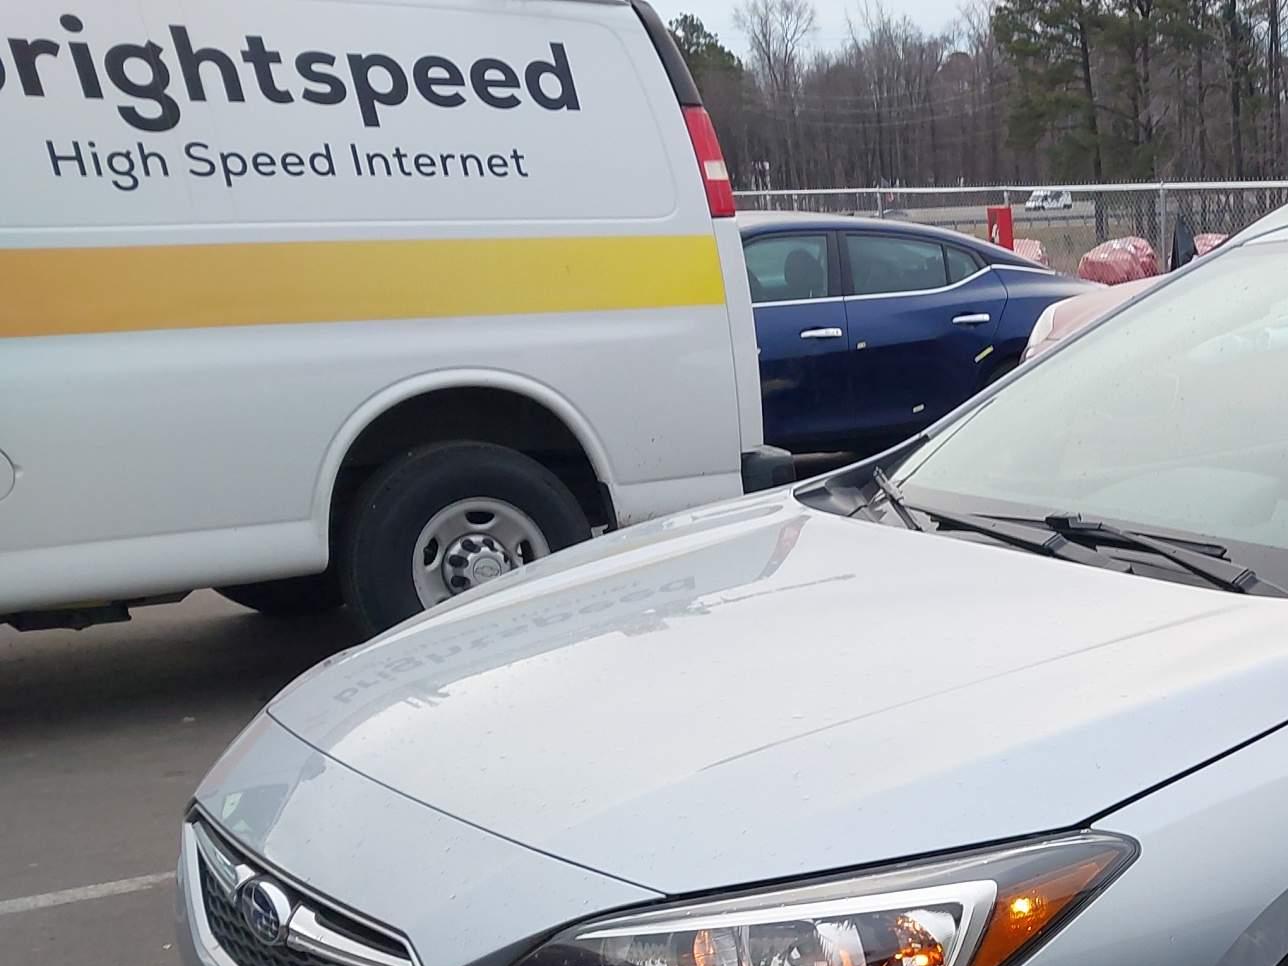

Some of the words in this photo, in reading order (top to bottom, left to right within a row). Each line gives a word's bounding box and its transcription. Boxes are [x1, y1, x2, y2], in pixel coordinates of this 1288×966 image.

[0, 14, 581, 132] rightspeed
[46, 140, 170, 192] High
[184, 141, 337, 188] Speed
[350, 143, 529, 179] Internet
